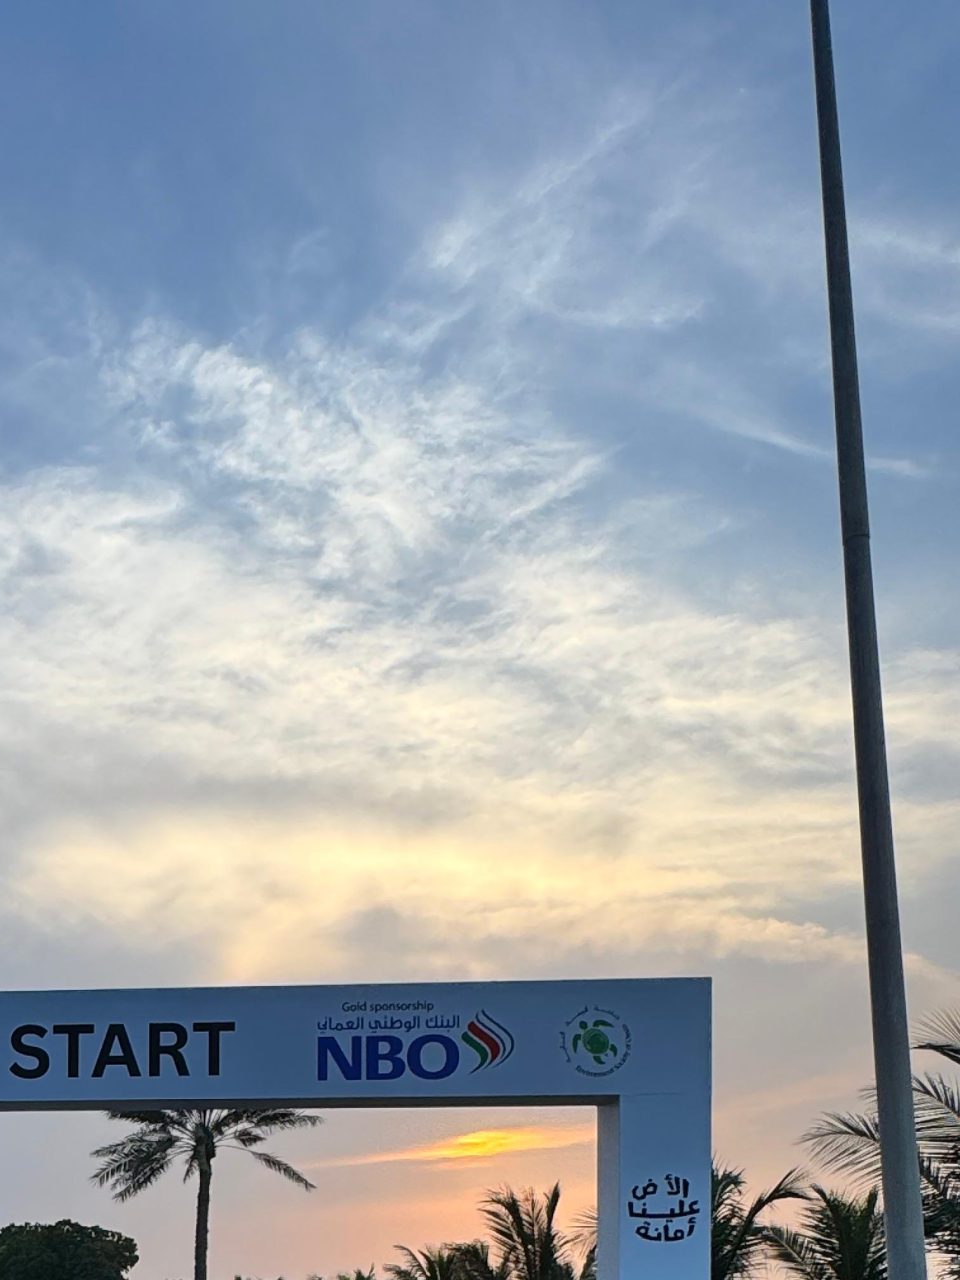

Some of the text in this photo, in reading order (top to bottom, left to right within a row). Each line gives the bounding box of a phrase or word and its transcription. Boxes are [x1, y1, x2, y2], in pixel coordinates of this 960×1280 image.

[342, 1000, 434, 1013] Gold sponsorship
[317, 1015, 460, 1034] البنك الوطني العماني
[9, 1022, 236, 1079] START
[317, 1034, 460, 1081] NBO
[628, 1199, 700, 1222] علينا
[635, 1217, 696, 1242] أمانة
